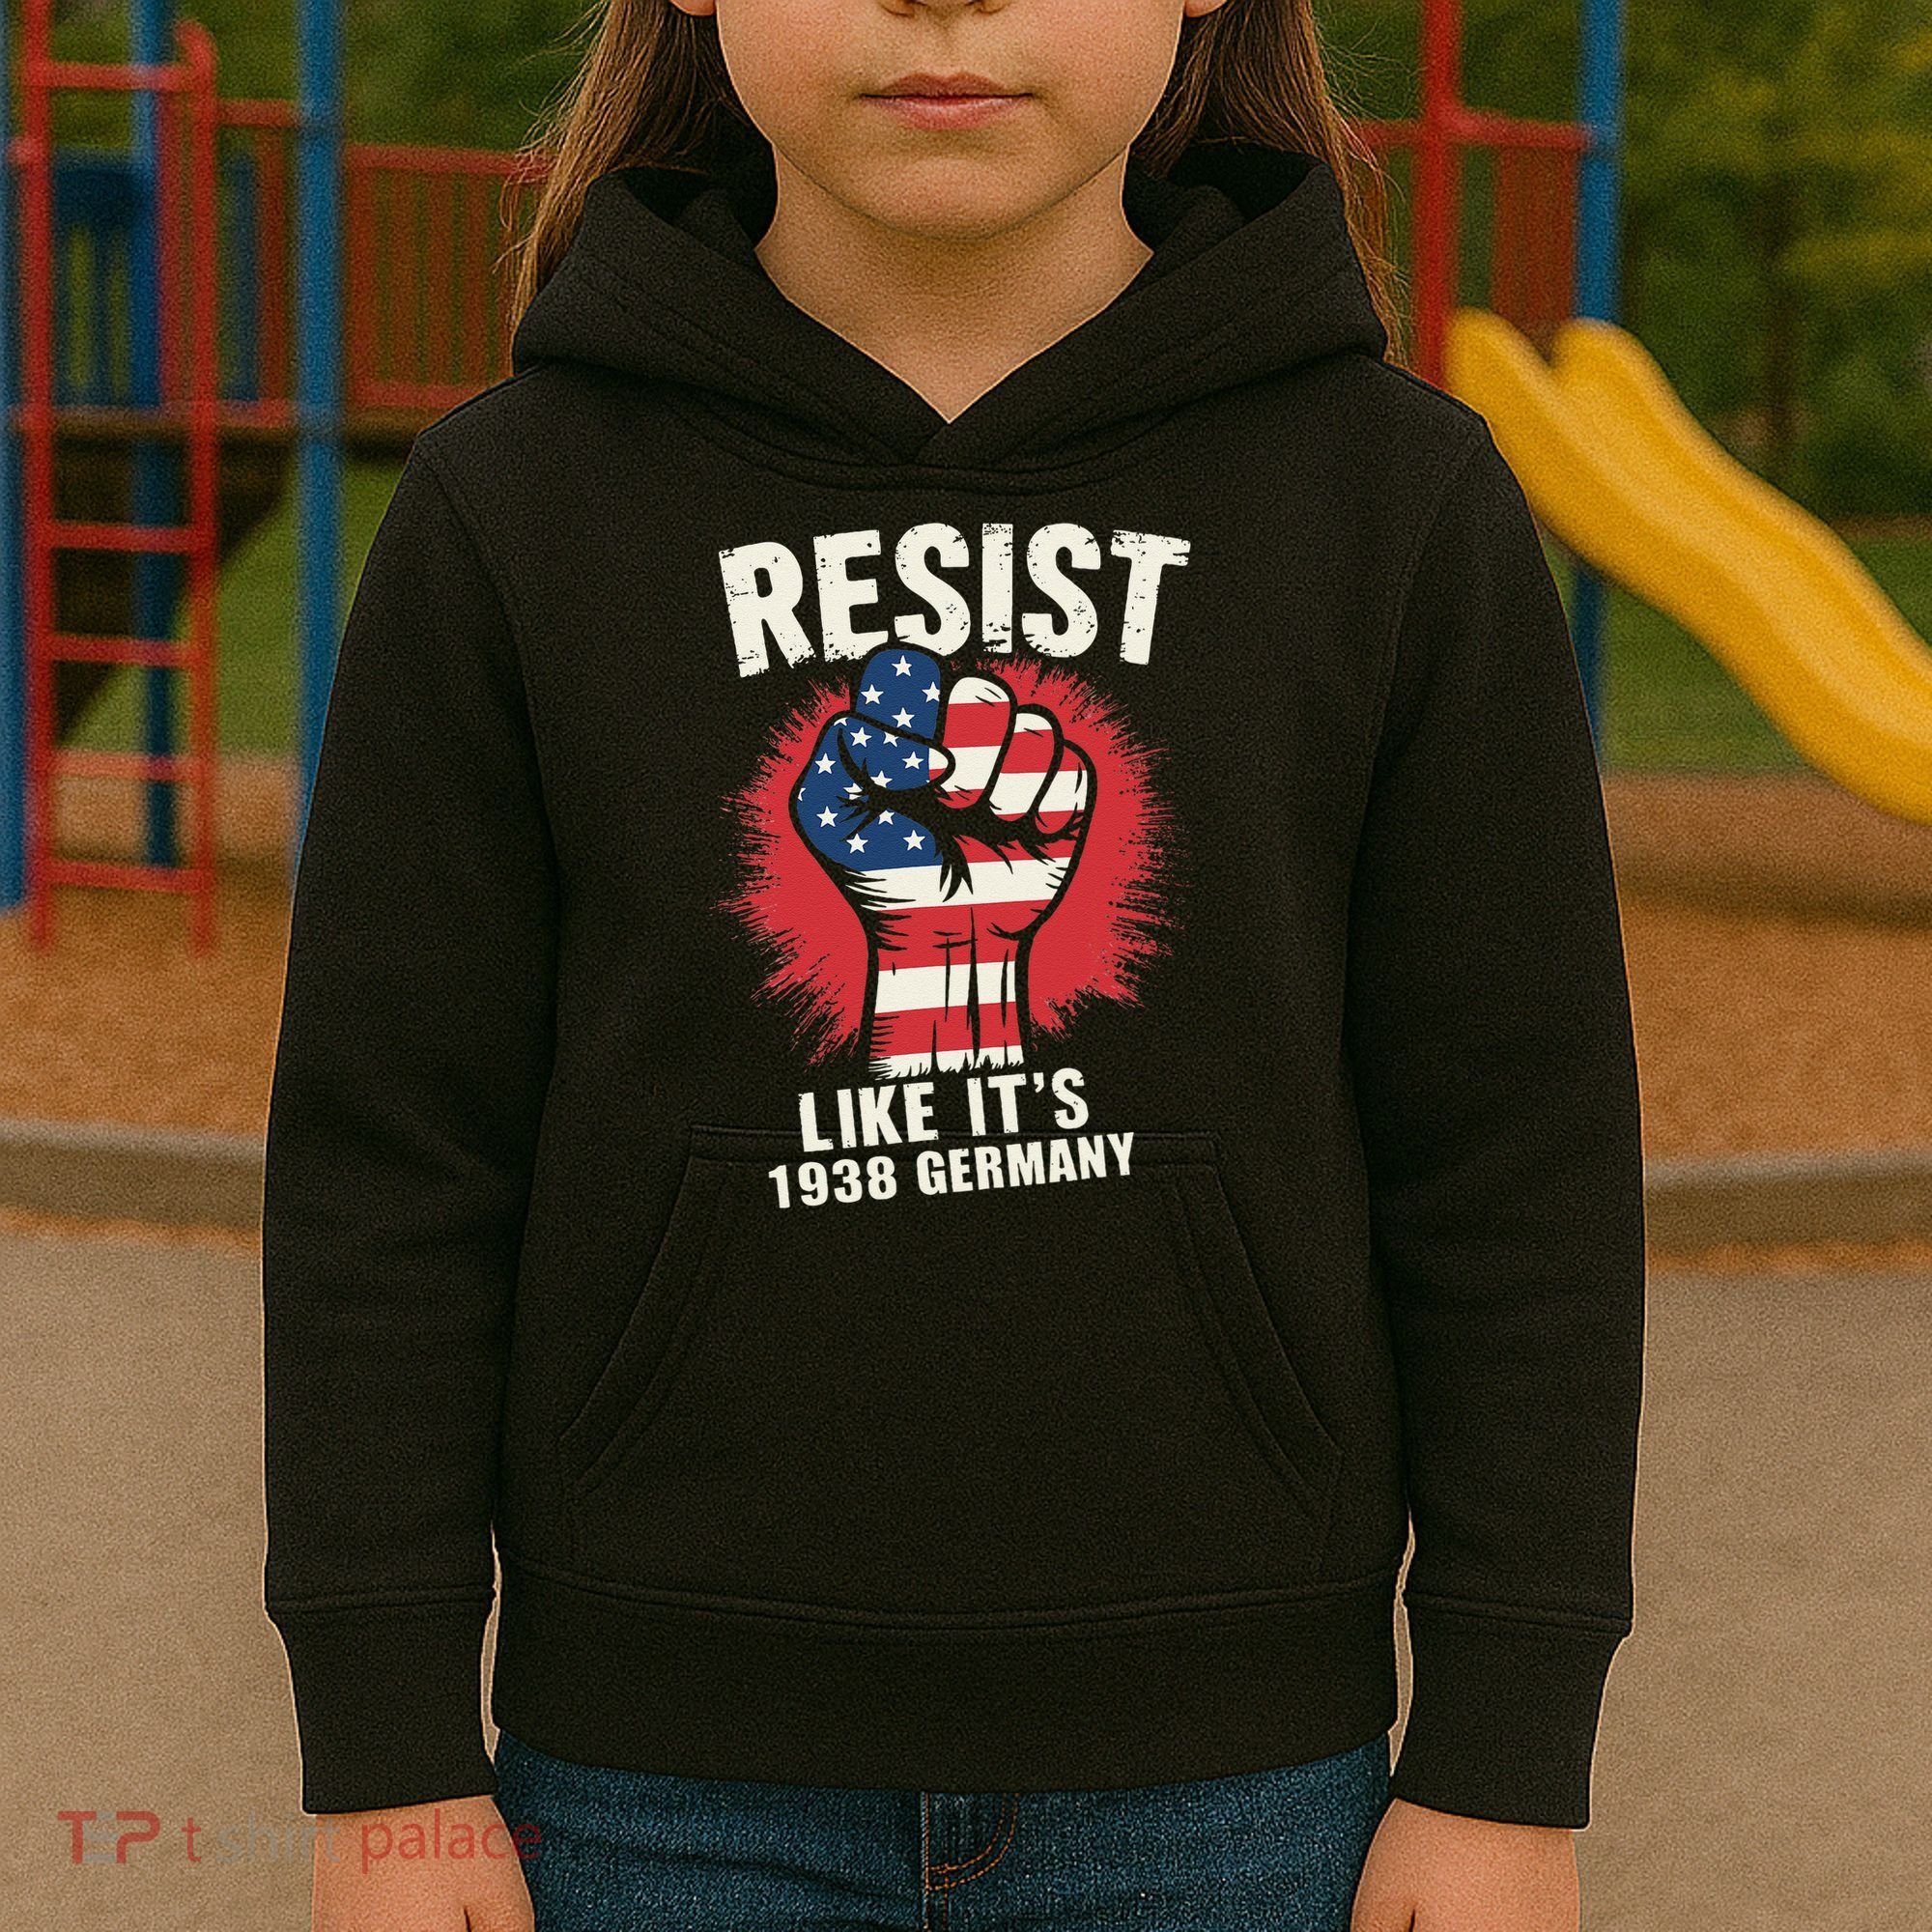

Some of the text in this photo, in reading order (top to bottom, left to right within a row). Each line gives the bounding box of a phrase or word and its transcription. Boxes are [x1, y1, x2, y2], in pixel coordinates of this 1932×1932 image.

[718, 523, 1191, 678] RESIST
[798, 1067, 1090, 1152] LIKE IT'S
[768, 1131, 1135, 1208] 1938 GERMANY
